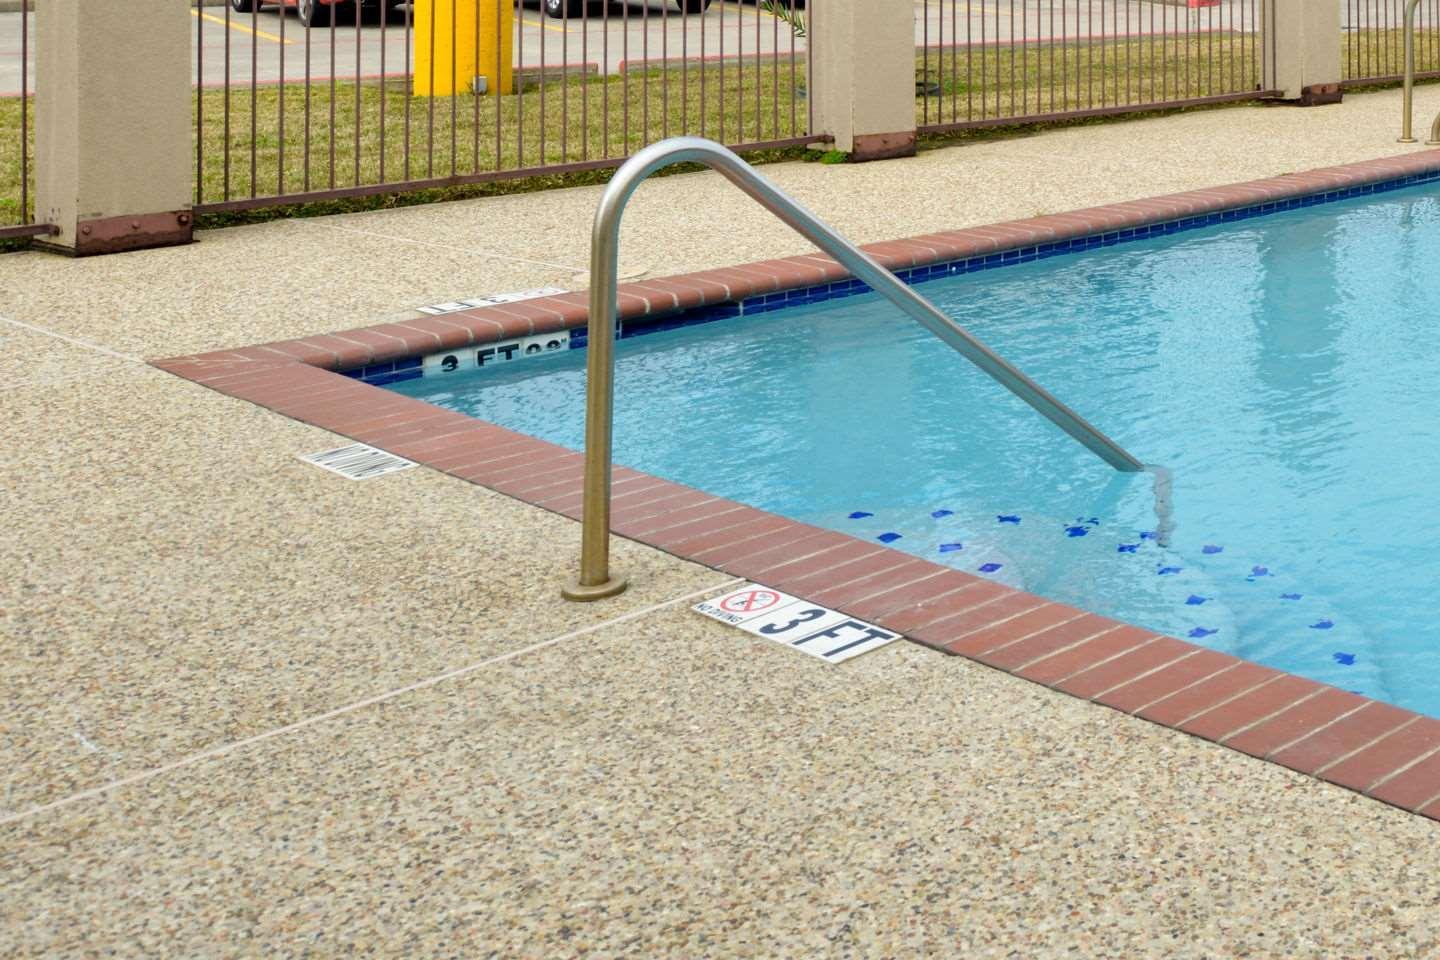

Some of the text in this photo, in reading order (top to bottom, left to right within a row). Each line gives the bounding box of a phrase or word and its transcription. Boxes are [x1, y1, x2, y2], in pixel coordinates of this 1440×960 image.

[441, 354, 459, 372] 3
[477, 343, 519, 366] FT
[759, 608, 895, 657] 3 FT
